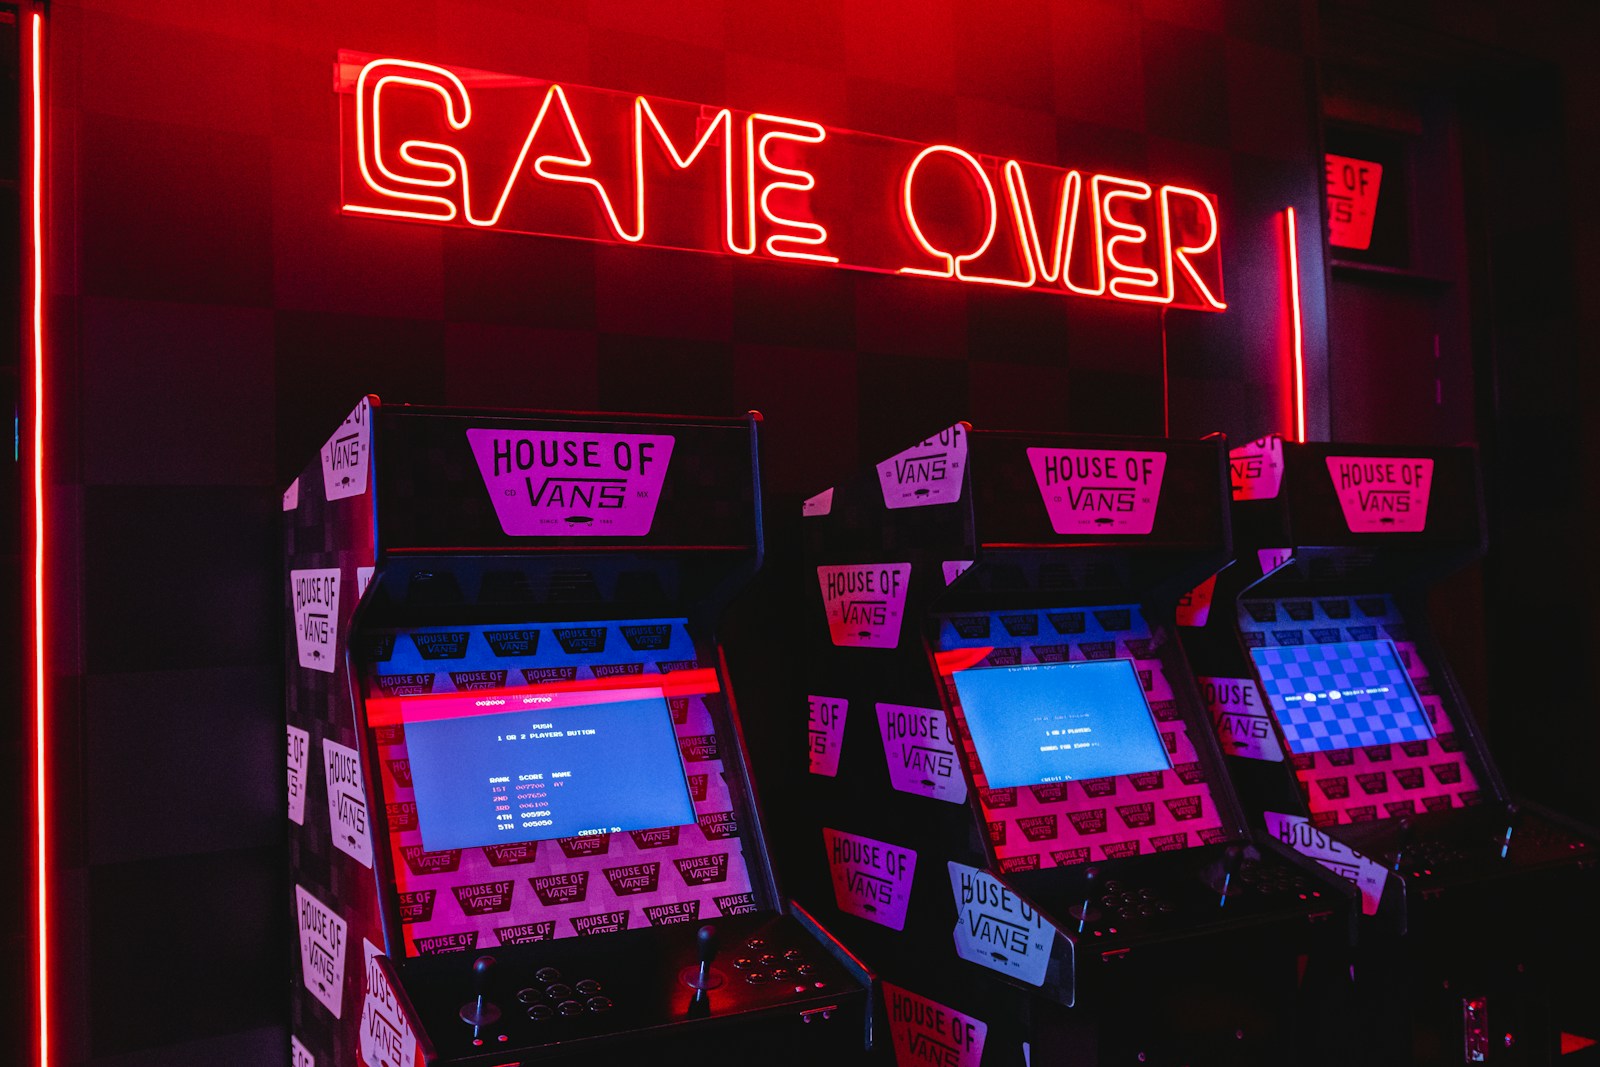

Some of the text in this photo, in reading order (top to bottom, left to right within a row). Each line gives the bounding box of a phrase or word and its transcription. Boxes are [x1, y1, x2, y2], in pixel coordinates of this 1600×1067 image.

[341, 57, 1227, 310] GAME OVER
[1342, 164, 1369, 196] OF
[330, 432, 360, 471] VANS
[493, 439, 655, 477] HOUSE OF
[895, 452, 948, 485] VANS
[1045, 455, 1153, 486] HOUSE OF
[1340, 463, 1423, 490] HOUSE OF
[504, 489, 517, 497] CD
[525, 477, 628, 509] VANS
[636, 490, 649, 498] MX
[1067, 486, 1136, 512] VANS
[1358, 490, 1411, 513] VANS
[828, 570, 901, 600] HOUSE OF
[296, 577, 322, 612] HOUSE
[323, 576, 336, 611] OF
[841, 601, 888, 625] VANS
[303, 613, 329, 644] VANS
[559, 629, 603, 641] HOUSE OF
[417, 633, 465, 645] HOUSE OF
[489, 631, 536, 643] HOUSE OF
[428, 644, 458, 653] VANS
[500, 641, 529, 650] VANS
[455, 671, 503, 685] HOUSE OF
[527, 668, 573, 681] HOUSE OF
[595, 665, 640, 678] HOUSE OF
[381, 674, 430, 688] HOUSE OF
[391, 686, 423, 696] VANS
[1206, 683, 1254, 706] OUSE
[673, 700, 685, 710] OF
[820, 703, 839, 730] OF
[529, 731, 564, 739] PLAYERS
[567, 729, 596, 737] BUTTON
[887, 711, 940, 741] HOUSE
[680, 736, 708, 749] HOUSE
[294, 735, 304, 769] OF
[690, 746, 718, 756] VANS
[329, 749, 358, 788] HOUSE
[902, 743, 954, 778] VANS
[489, 771, 572, 784] RANK SCORE NAME
[515, 783, 545, 791] 007700
[517, 792, 547, 800] 007650
[337, 789, 366, 835] VANS
[519, 801, 549, 809] 006100
[520, 810, 551, 819] 005950
[699, 812, 730, 827] HOUSE
[497, 819, 553, 831] 5TH 005050
[578, 828, 607, 837] CREDIT
[710, 822, 738, 834] VANS
[641, 830, 671, 843] VANS
[570, 839, 601, 851] VANS
[417, 855, 451, 868] VANS
[495, 847, 527, 860] VANS
[832, 836, 907, 881] HOUSE OF
[679, 854, 725, 871] HOUSE OF
[608, 864, 656, 881] HOUSE OF
[690, 866, 719, 879] VANS
[535, 873, 584, 891] HOUSE OF
[620, 876, 650, 889] VANS
[846, 868, 893, 905] VANS
[416, 891, 431, 903] OF
[459, 882, 509, 900] HOUSE OF
[546, 885, 578, 898] VANS
[469, 895, 502, 908] VANS
[719, 895, 749, 909] HOUSE
[649, 902, 696, 920] HOUSE OF
[301, 897, 342, 958] HOUSE OF
[576, 912, 625, 931] HOUSE OF
[500, 928, 534, 942] HOUSE
[536, 923, 550, 934] OF
[968, 909, 1030, 955] VANS
[420, 937, 455, 953] HOUSE
[458, 933, 473, 946] OF
[309, 936, 335, 985] VANS
[893, 991, 976, 1053] HOUSE OF
